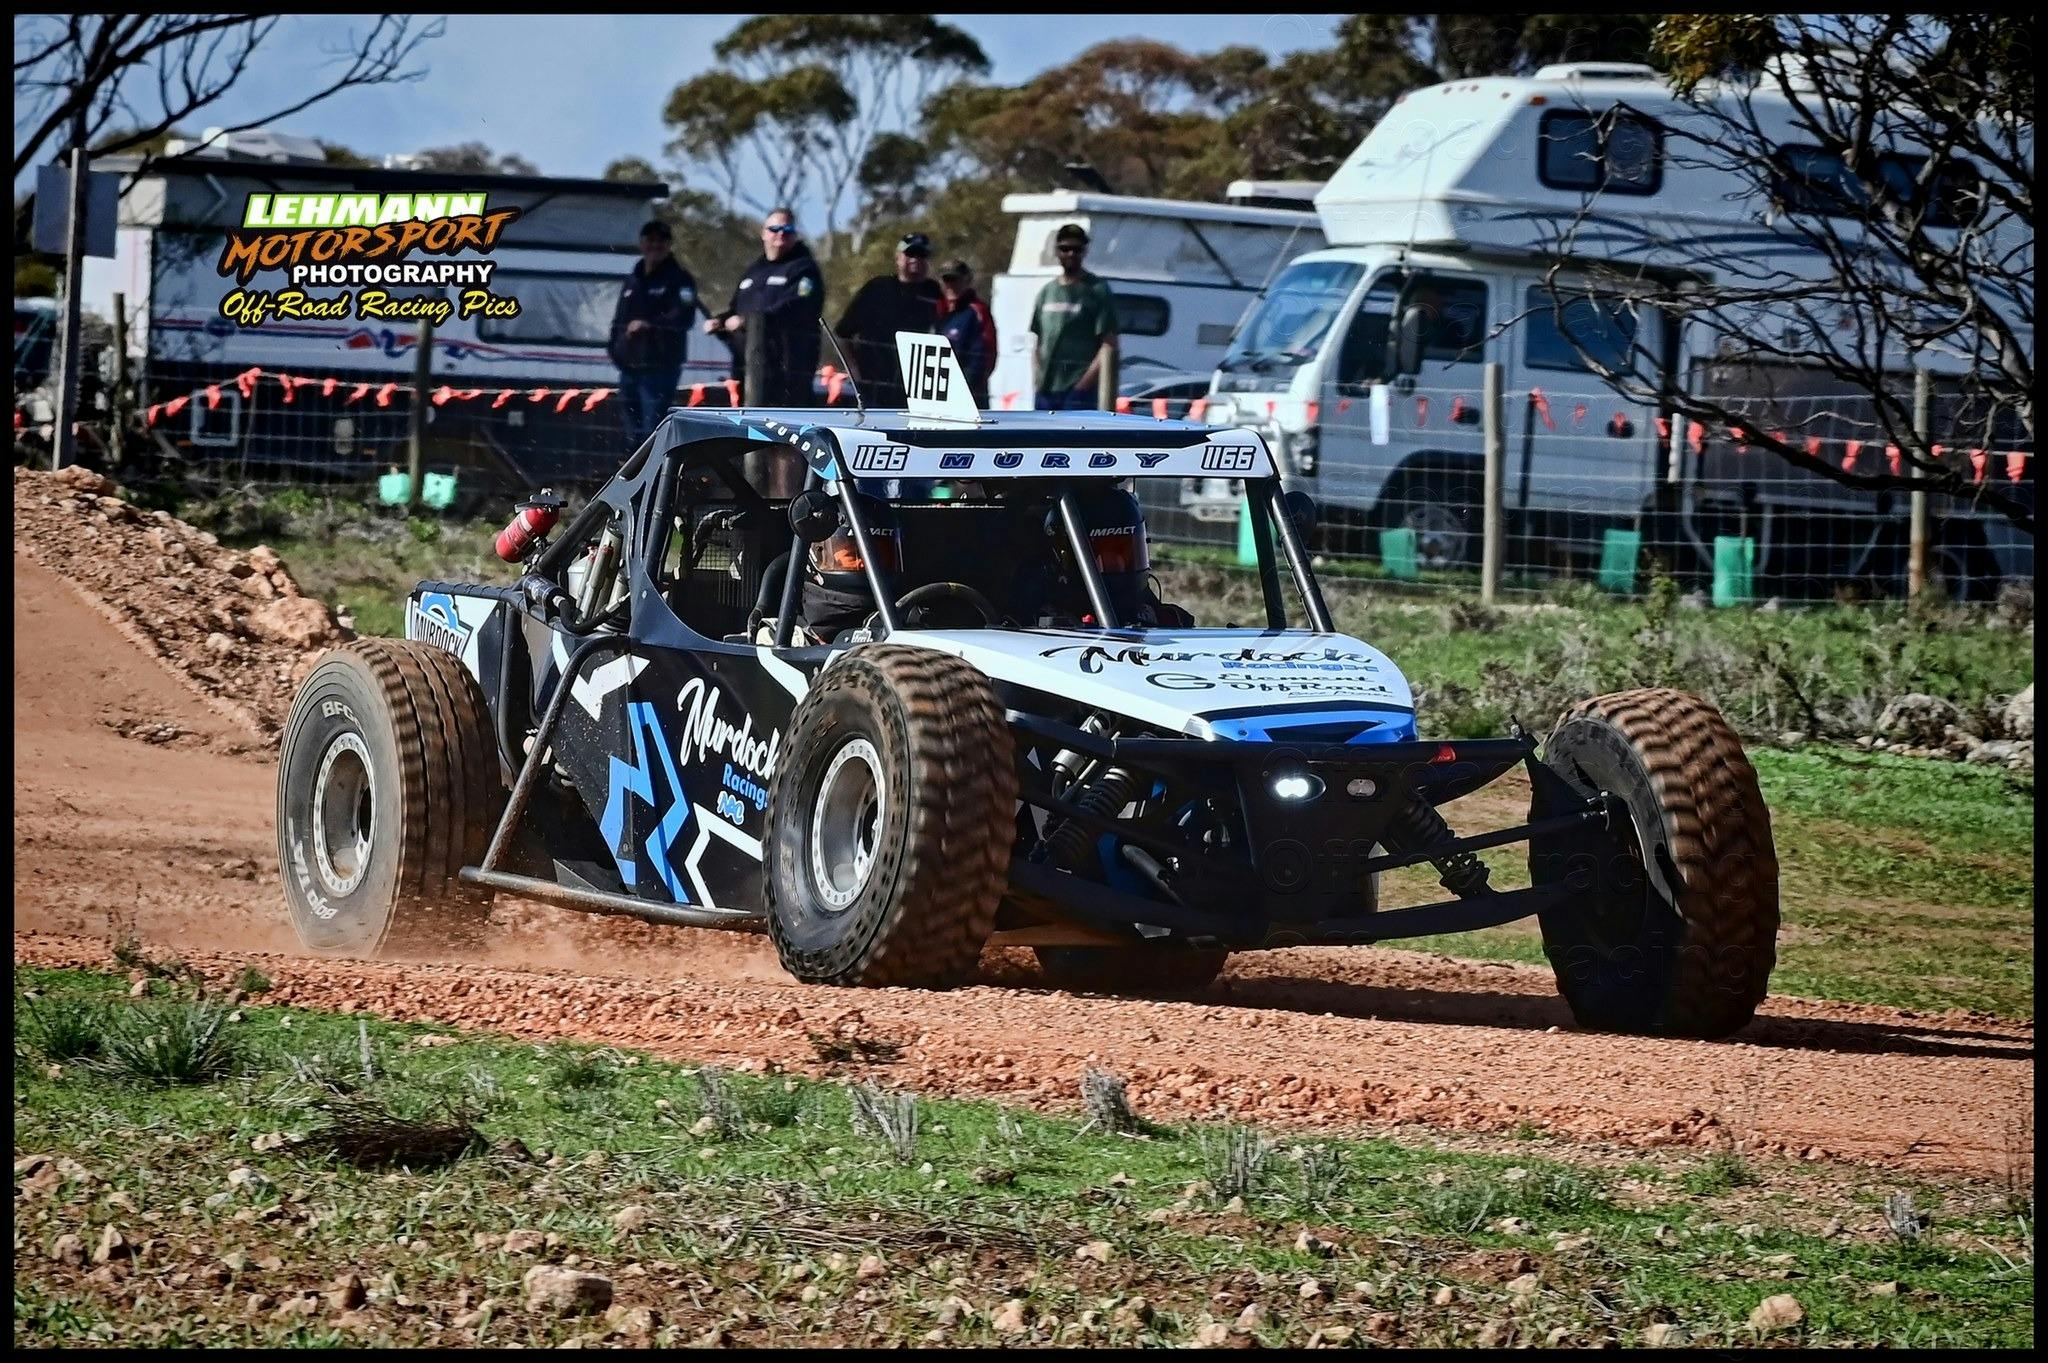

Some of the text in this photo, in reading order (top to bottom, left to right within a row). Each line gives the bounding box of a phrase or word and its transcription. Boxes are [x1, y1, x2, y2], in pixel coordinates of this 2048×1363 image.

[907, 344, 952, 402] 1166
[853, 445, 1257, 470] 1166 MURDY 1166
[1089, 525, 1136, 537] IMPACT
[414, 612, 463, 657] MURDOCK
[1039, 646, 1371, 674] Murdock
[677, 677, 780, 780] Murdock
